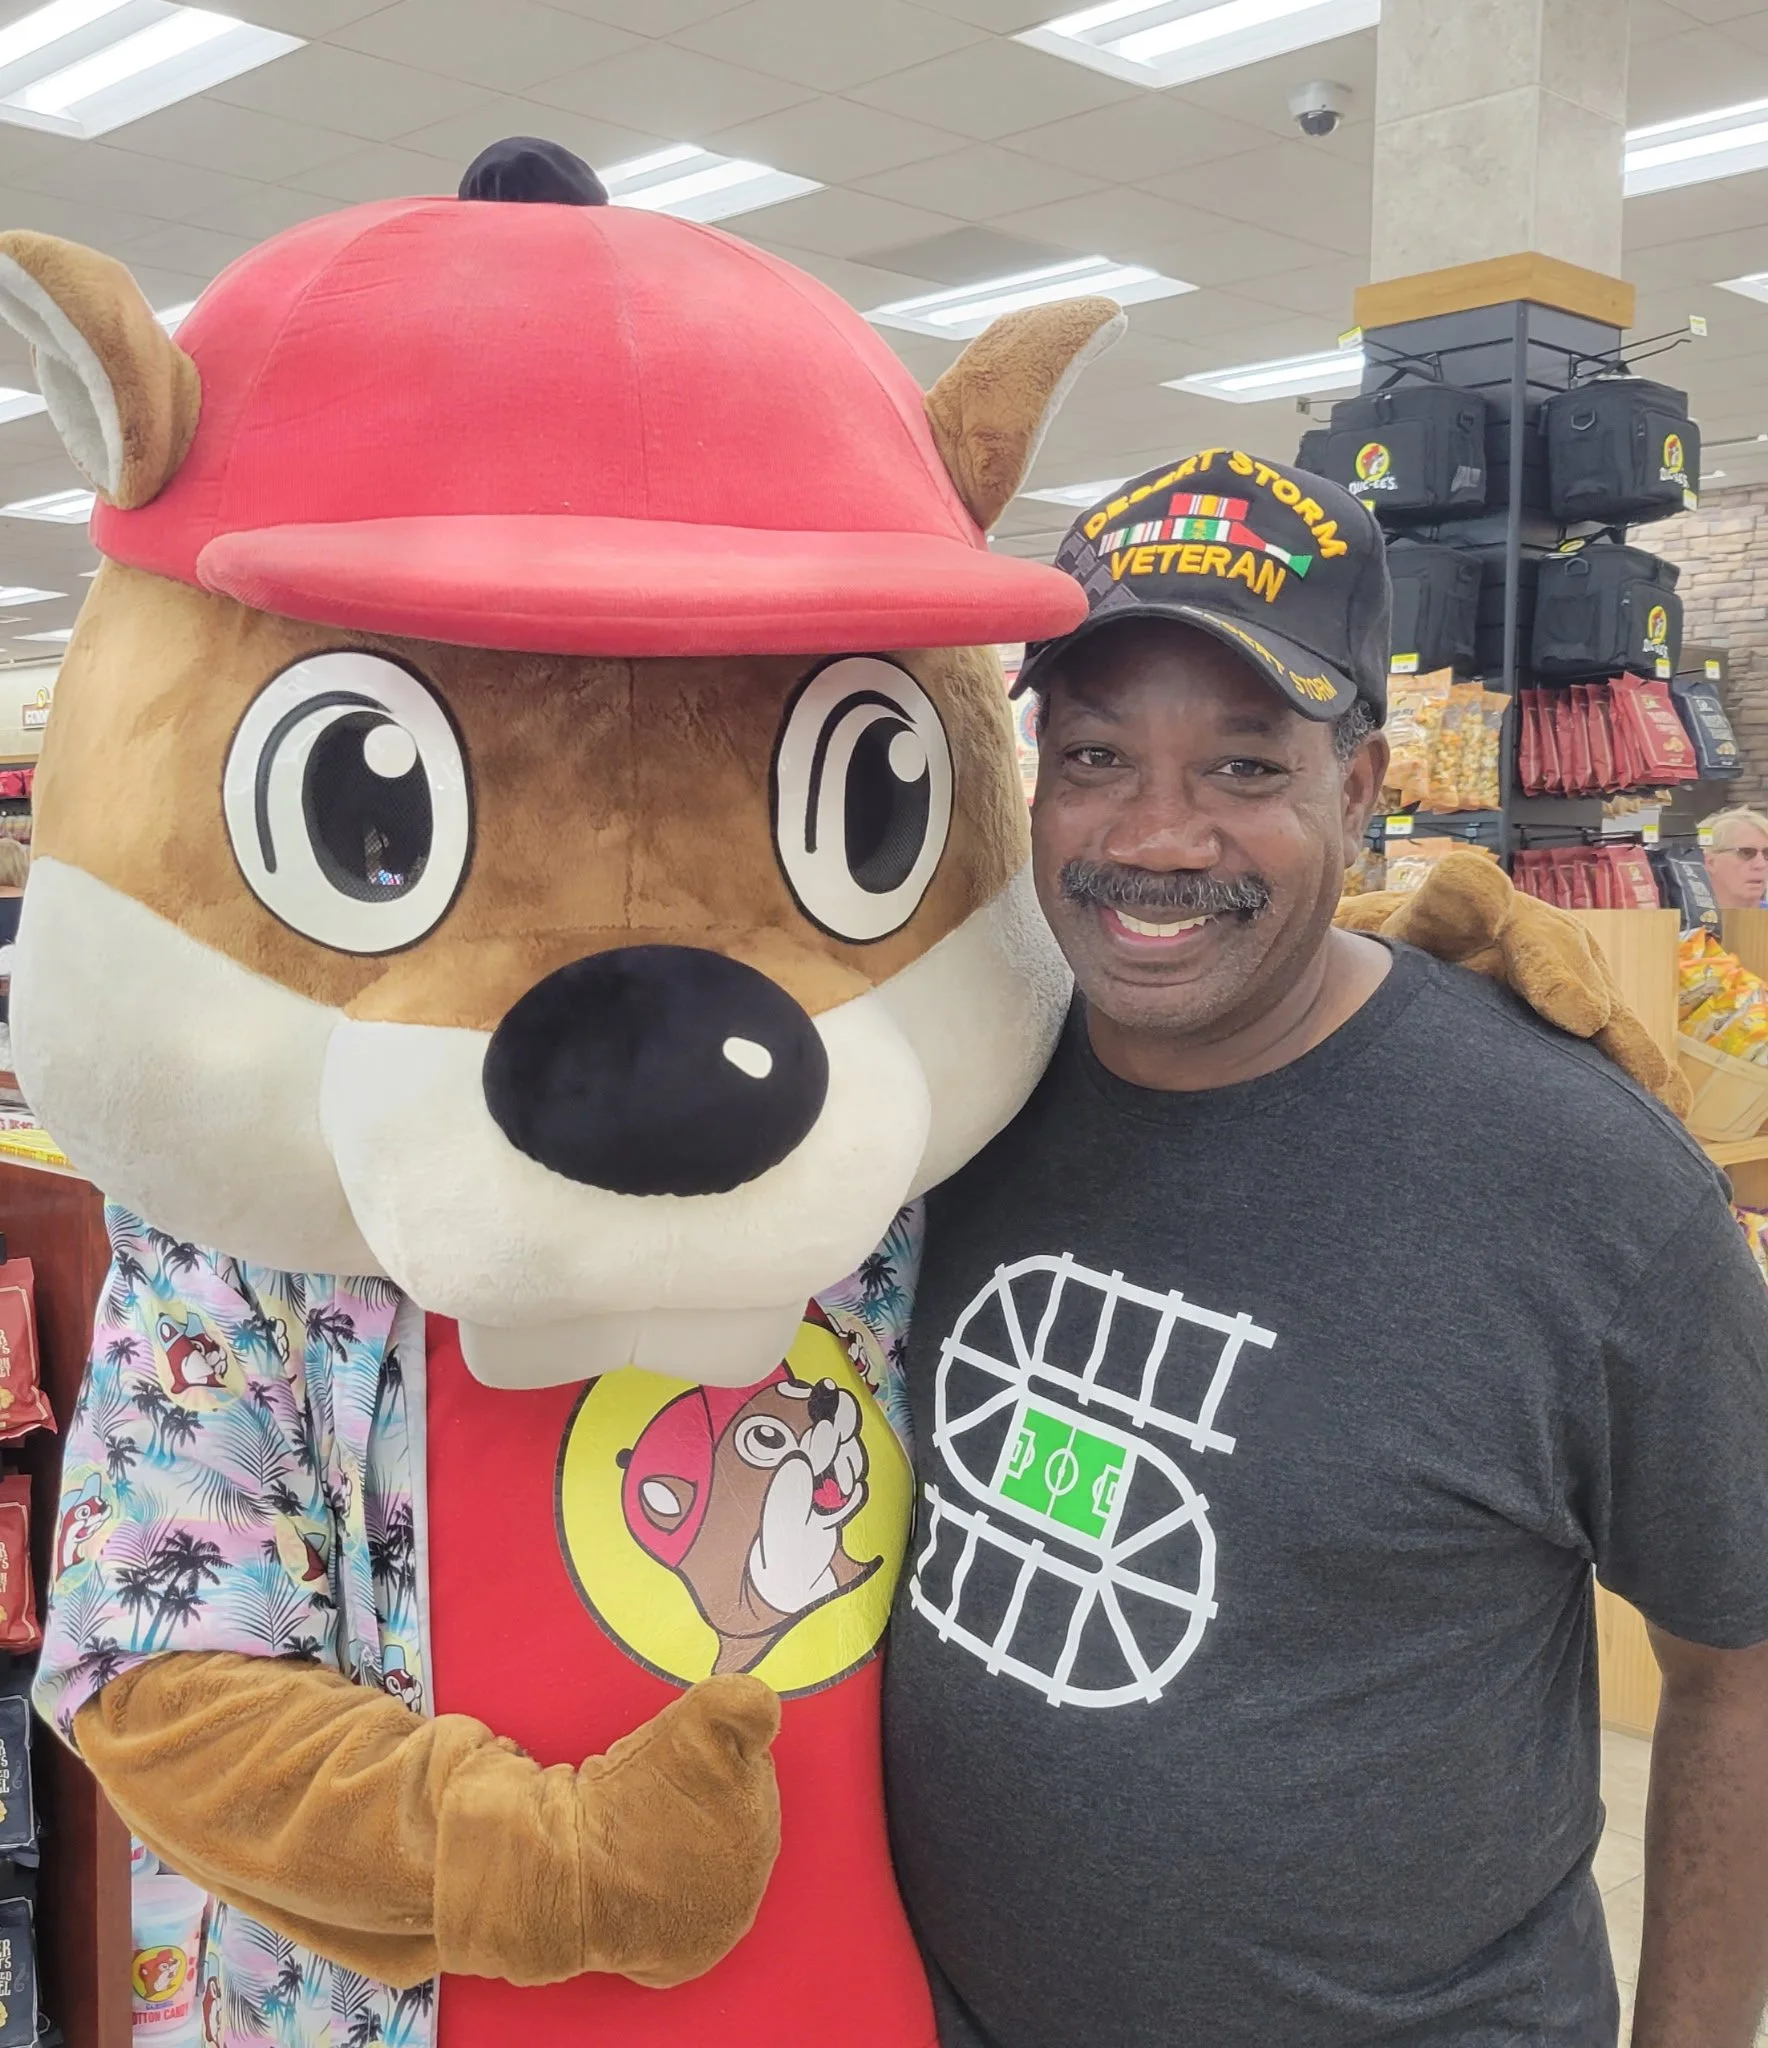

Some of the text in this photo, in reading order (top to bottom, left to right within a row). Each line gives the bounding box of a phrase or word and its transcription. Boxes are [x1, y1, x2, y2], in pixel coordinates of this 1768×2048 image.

[1228, 449, 1348, 559] STORM
[1111, 543, 1287, 603] VETERAN
[1288, 671, 1338, 702] STORM
[132, 2010, 161, 2026] OTTON
